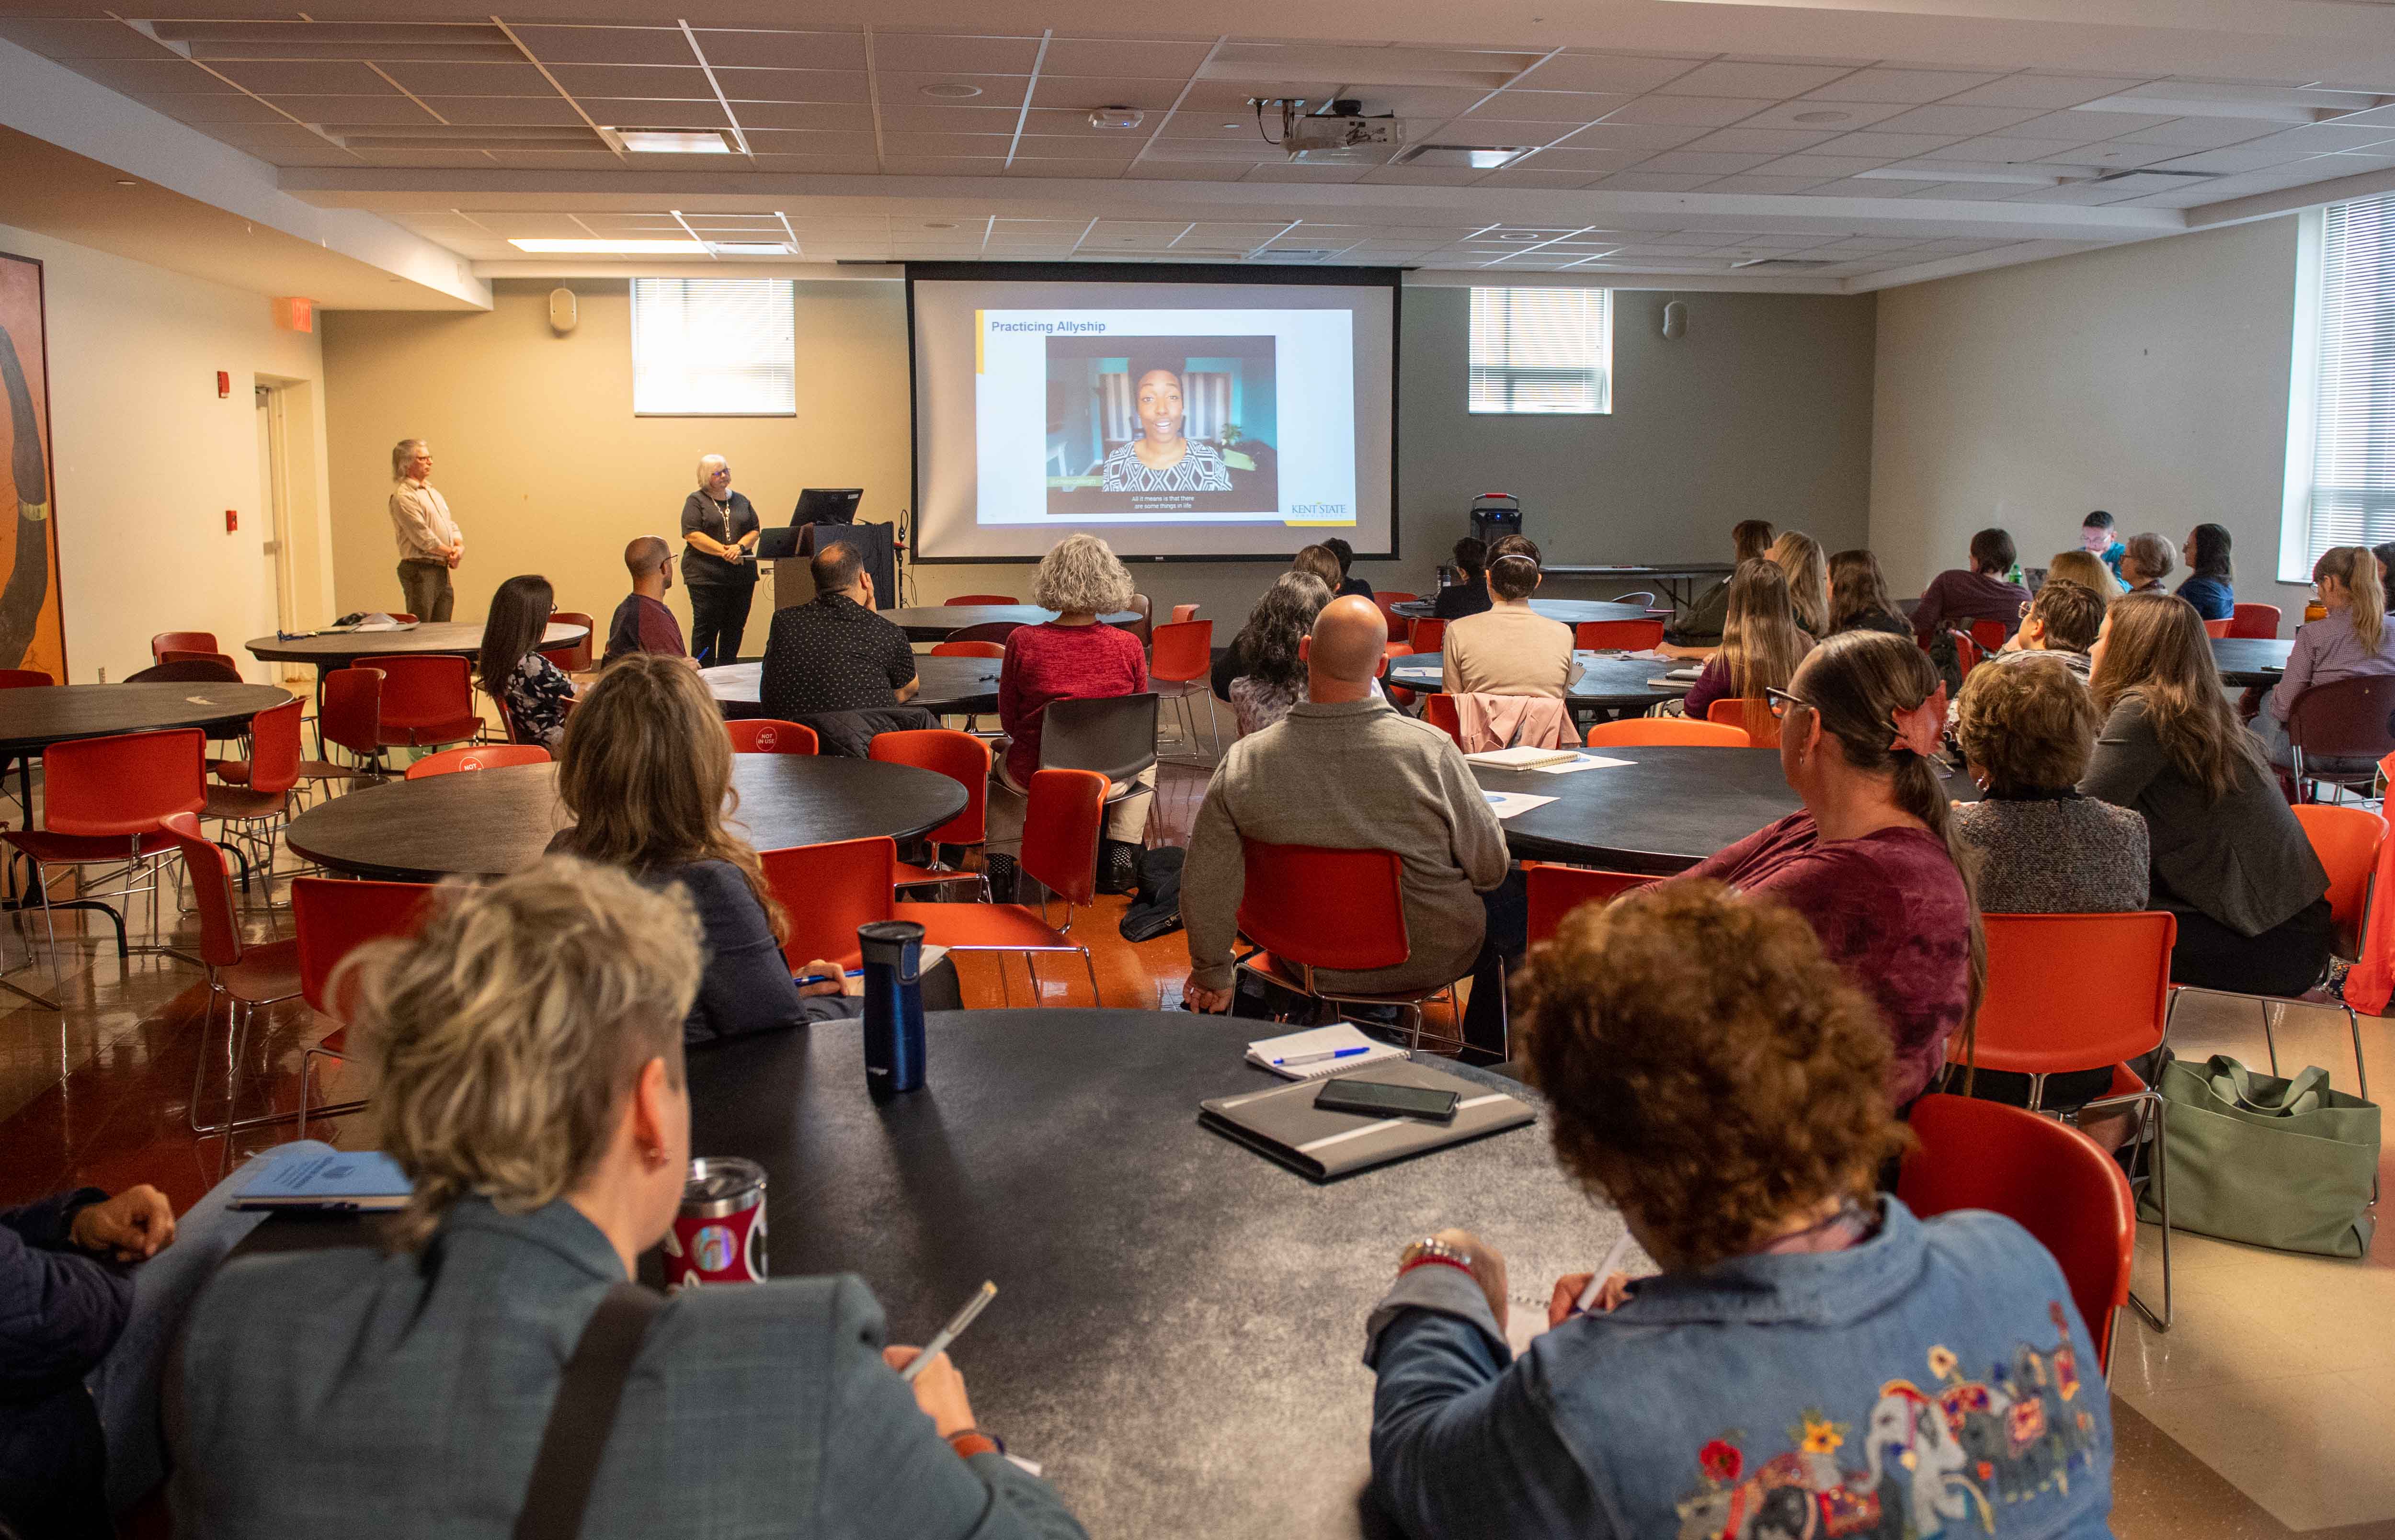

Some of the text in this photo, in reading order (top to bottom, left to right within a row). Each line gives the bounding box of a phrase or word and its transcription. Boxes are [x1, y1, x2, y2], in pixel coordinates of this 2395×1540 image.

[992, 321, 1106, 333] Practicing Allyship
[1292, 504, 1347, 514] KENT STATE
